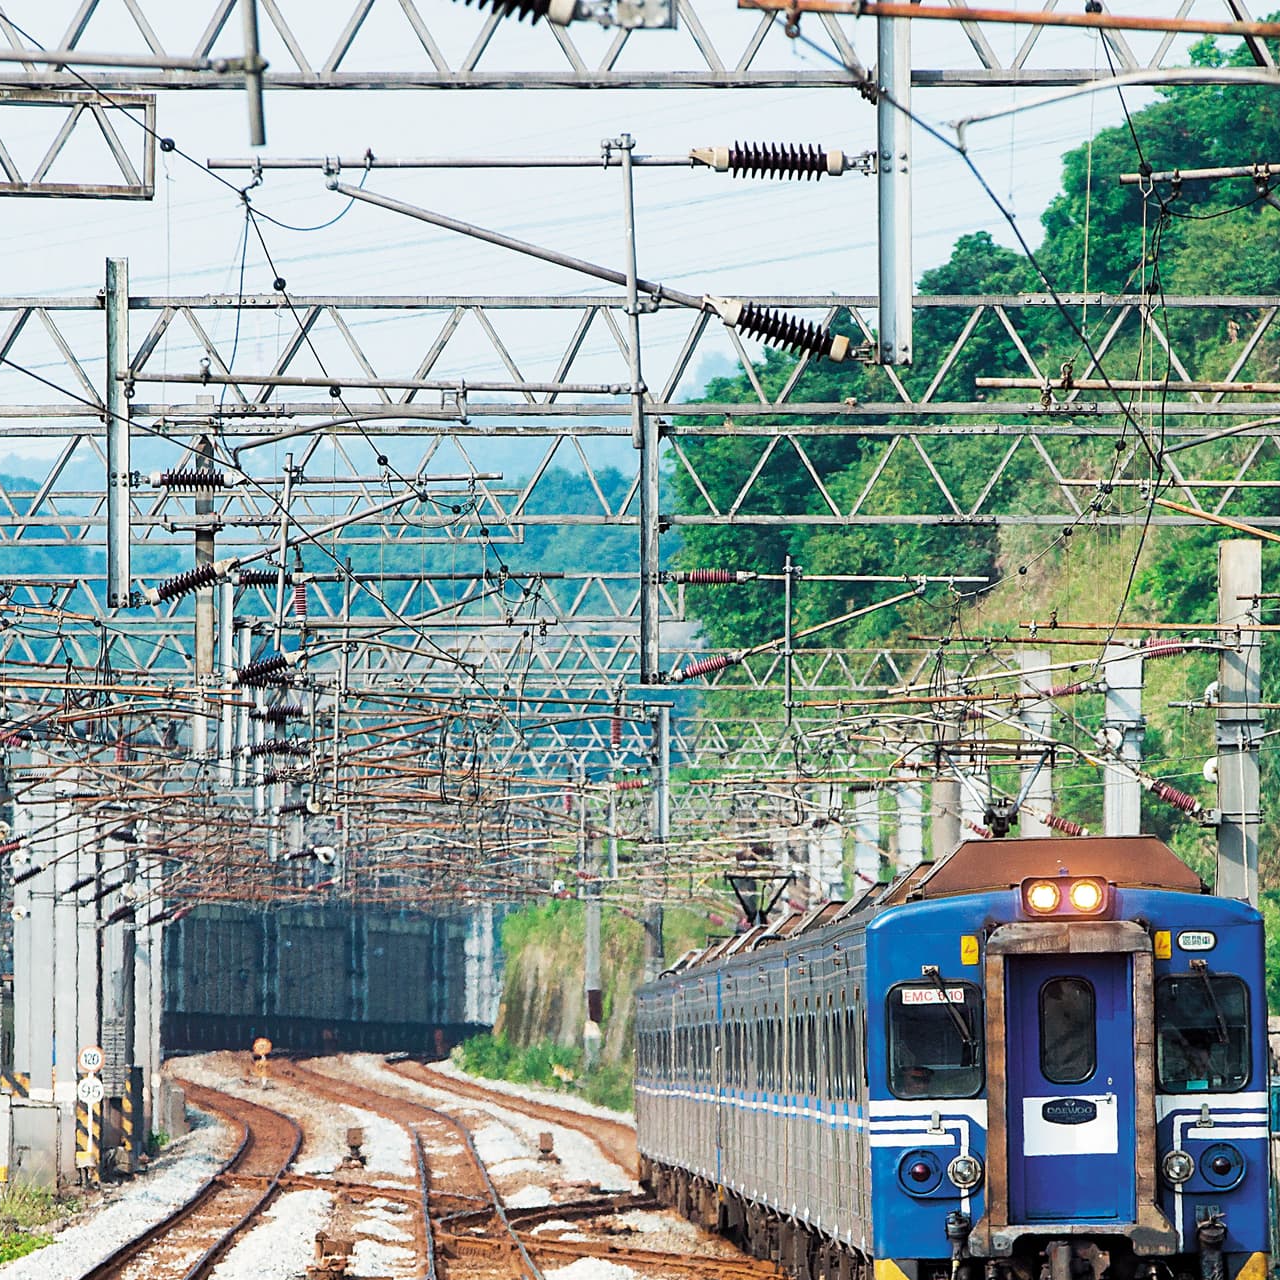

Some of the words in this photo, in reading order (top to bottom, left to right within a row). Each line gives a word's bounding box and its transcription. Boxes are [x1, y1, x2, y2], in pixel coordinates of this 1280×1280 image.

[904, 991, 933, 1002] EMC
[84, 1053, 100, 1065] 120
[81, 1083, 101, 1098] 95
